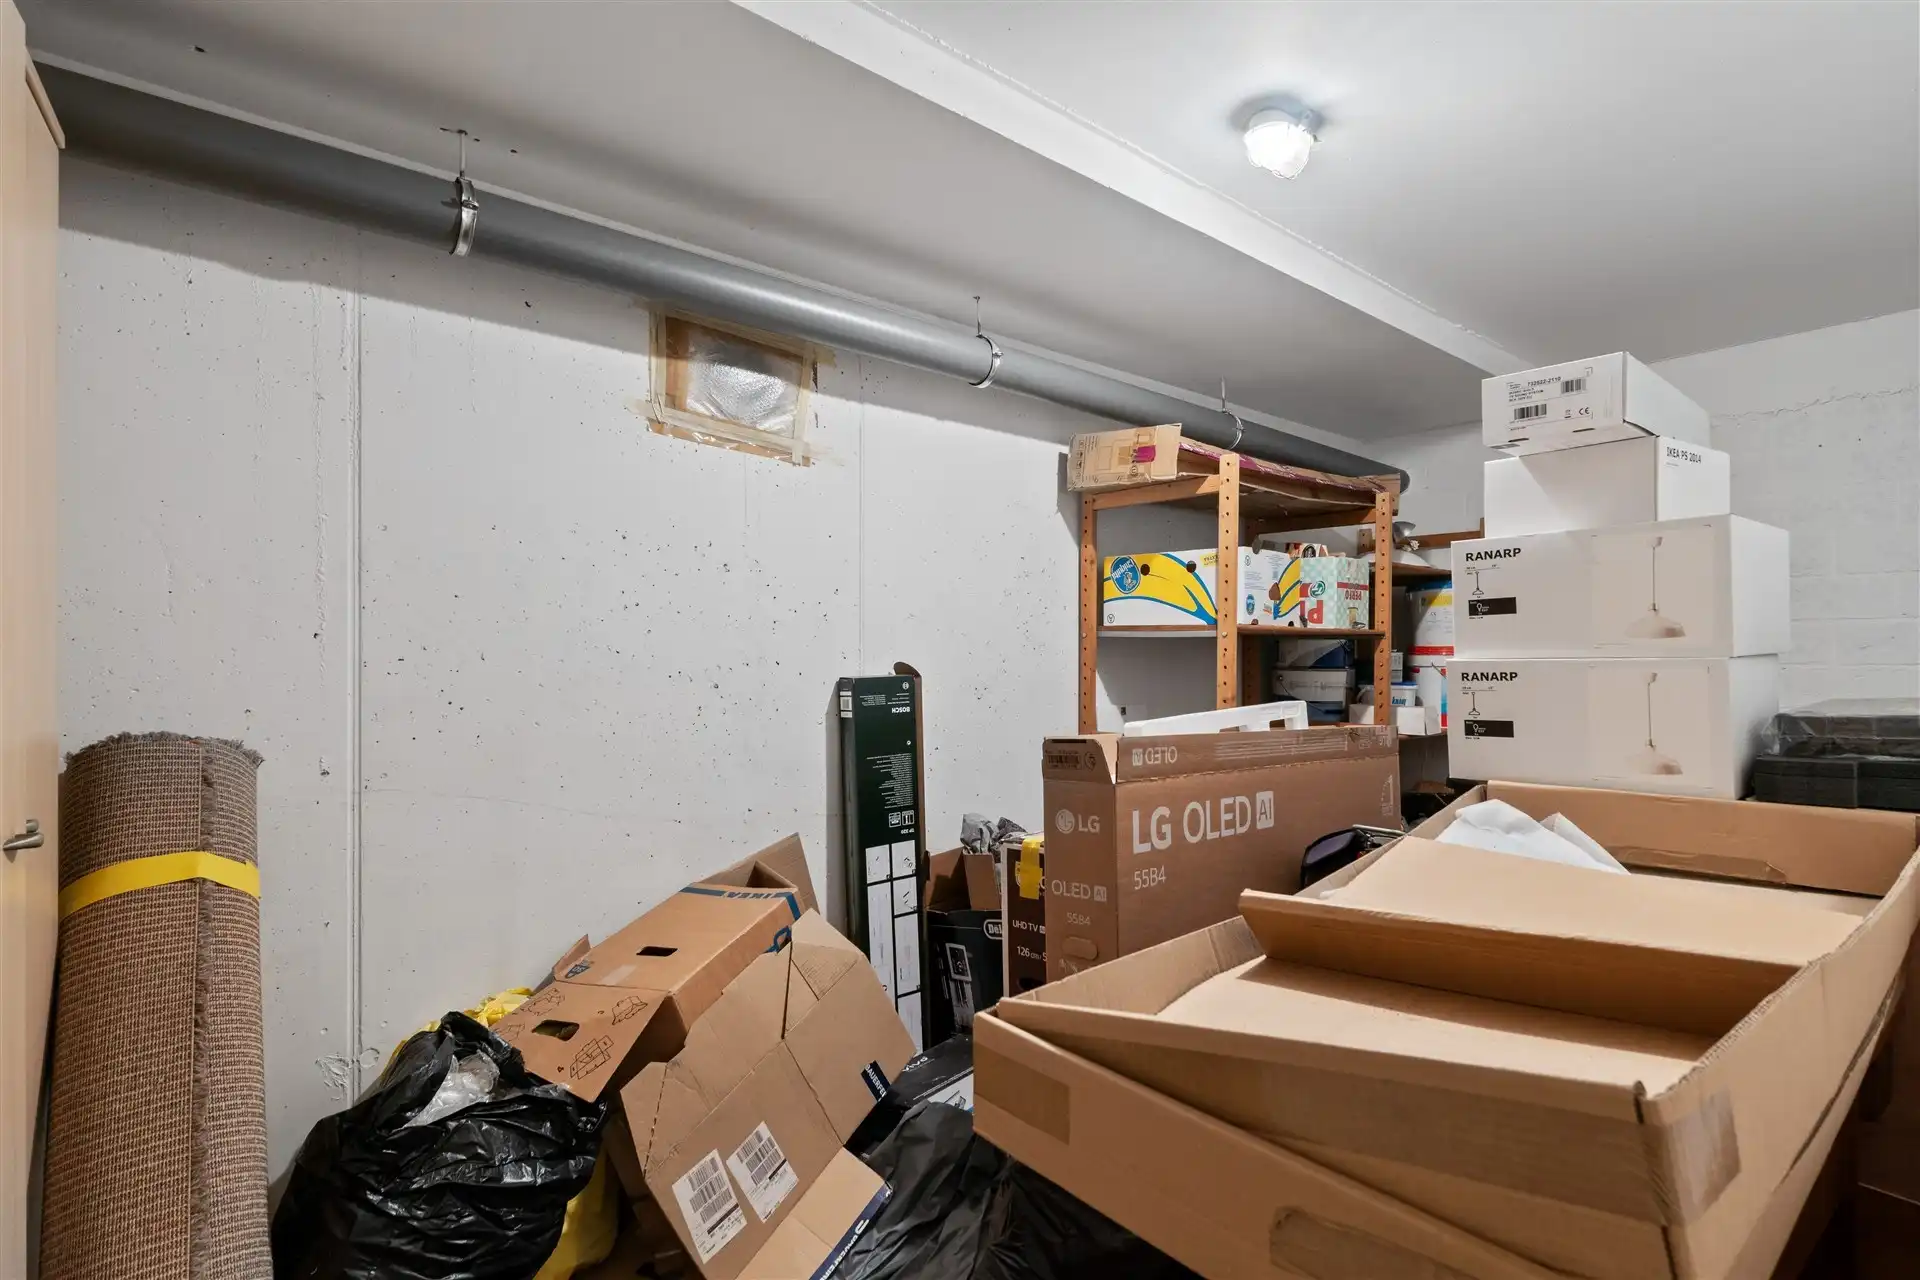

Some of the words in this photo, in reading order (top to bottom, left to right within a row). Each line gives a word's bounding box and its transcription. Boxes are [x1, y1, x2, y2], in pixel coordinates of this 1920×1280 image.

[1666, 446, 1680, 458] IKEA
[1465, 547, 1522, 562] RANARP
[1461, 671, 1518, 682] RANARP
[891, 706, 911, 714] BOSCH
[1144, 745, 1178, 765] OLED
[1078, 814, 1100, 834] LG
[1132, 806, 1172, 855] LG
[1183, 795, 1252, 844] OLED
[1258, 796, 1272, 822] AI
[1133, 864, 1167, 892] 55B4
[1051, 879, 1091, 900] OLED
[1012, 919, 1027, 930] UHD
[1027, 922, 1038, 933] TV
[1066, 911, 1091, 926] 55B4
[1016, 945, 1030, 958] 126
